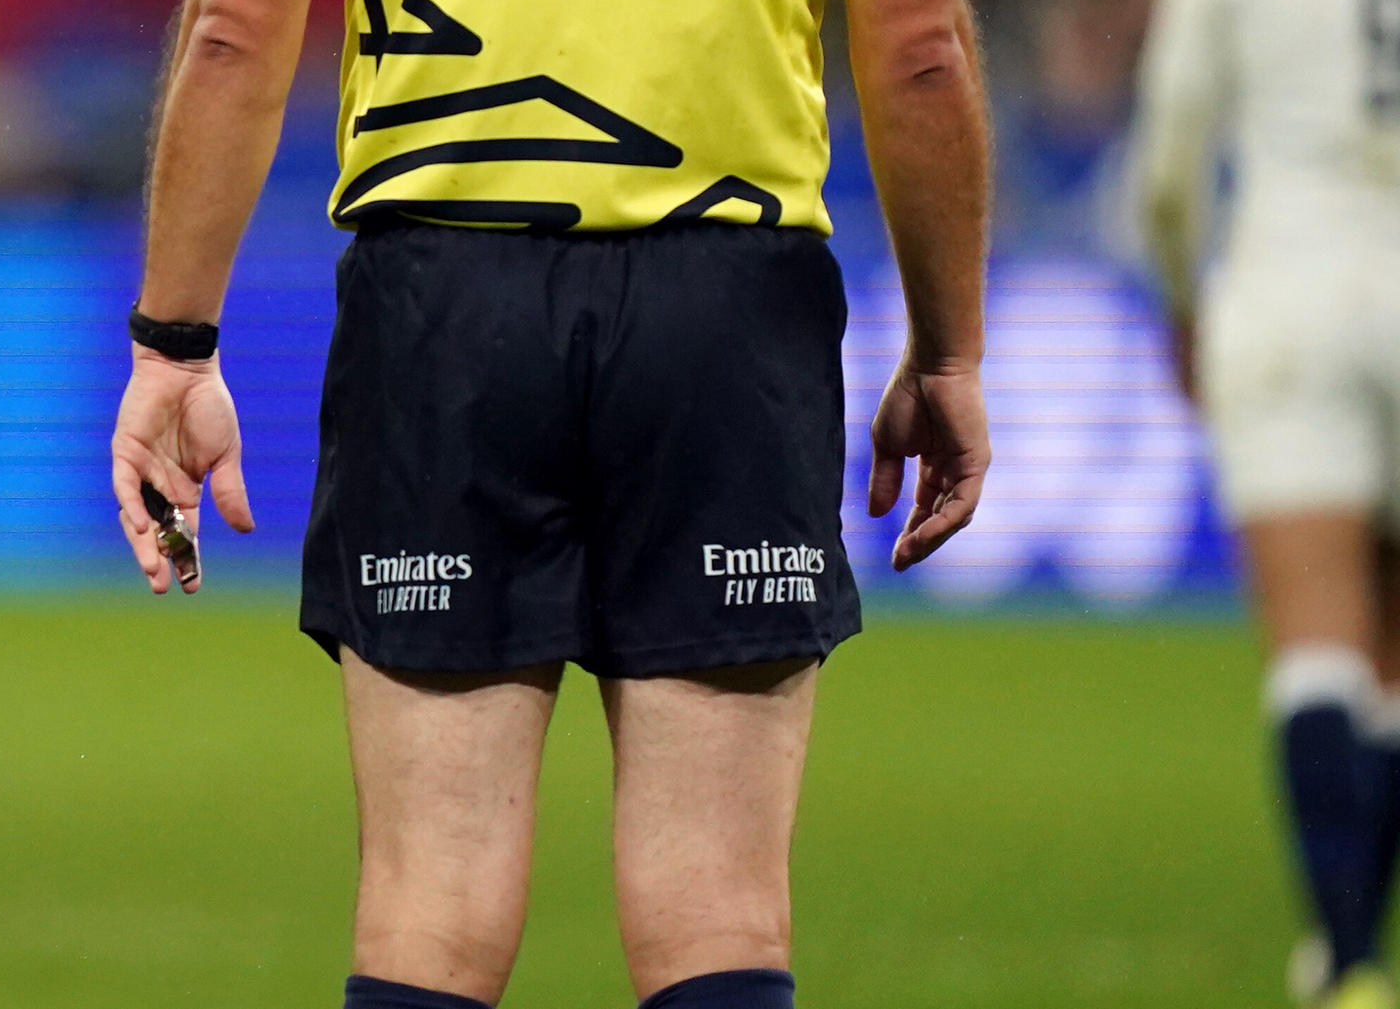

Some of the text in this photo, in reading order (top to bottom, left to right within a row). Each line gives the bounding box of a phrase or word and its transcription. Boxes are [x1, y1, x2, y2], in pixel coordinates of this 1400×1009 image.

[360, 549, 472, 586] Emirates
[702, 540, 825, 576] Emirates
[724, 576, 817, 606] FLY BETTER
